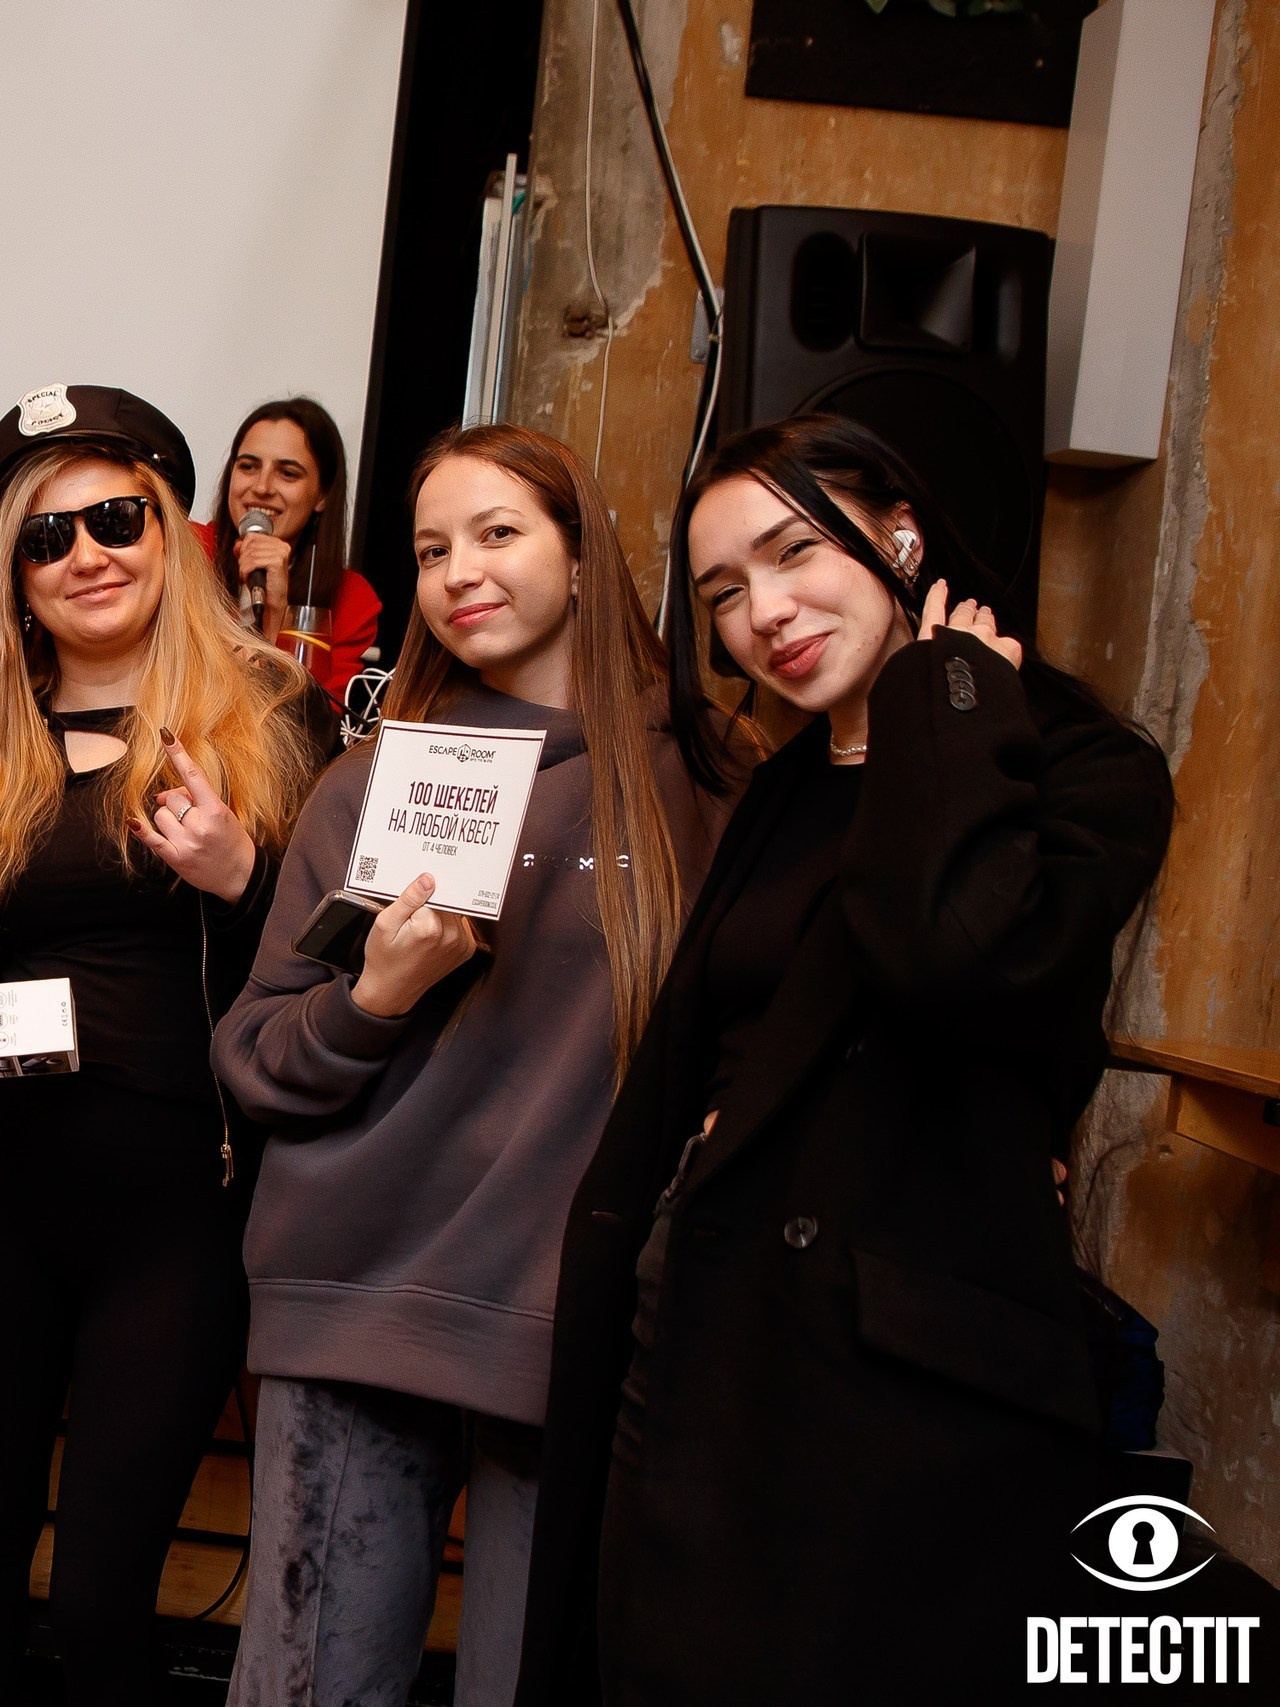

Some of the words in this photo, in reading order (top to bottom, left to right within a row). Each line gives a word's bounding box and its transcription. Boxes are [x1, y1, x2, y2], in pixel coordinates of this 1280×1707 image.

[428, 745, 457, 756] ESCAPE
[471, 749, 494, 759] ROOM
[408, 781, 433, 806] 100
[433, 784, 499, 814] ШЕКЕЛЕЙ
[388, 808, 408, 833] НА
[409, 811, 459, 841] ЛЮБОЙ
[458, 818, 500, 846] КВЕСТ
[422, 841, 430, 852] ОТ
[434, 843, 458, 856] ЧЕЛОВЕК
